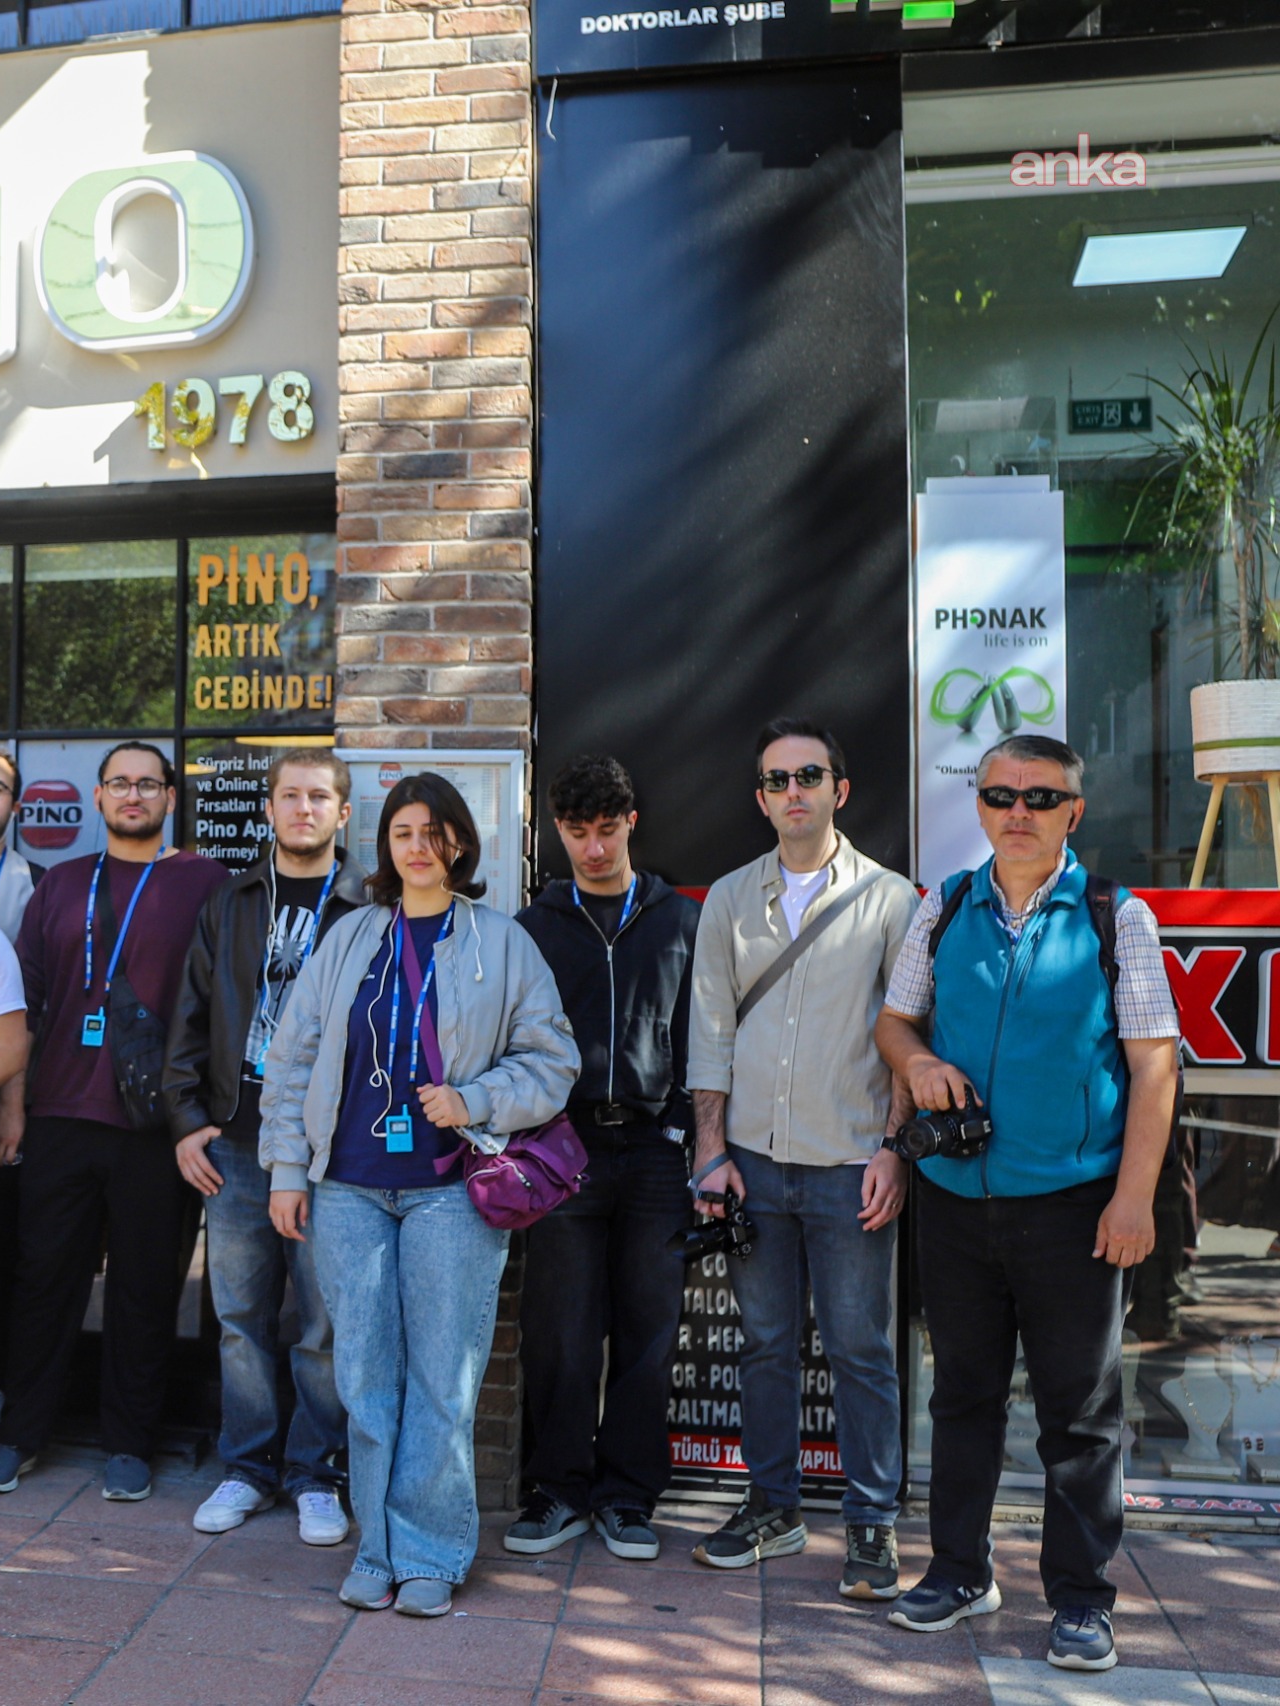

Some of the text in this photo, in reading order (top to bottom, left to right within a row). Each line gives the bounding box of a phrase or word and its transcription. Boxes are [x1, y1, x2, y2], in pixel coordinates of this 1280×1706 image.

[581, 1, 786, 34] DOKTORLAR ŞUBE
[134, 370, 315, 451] 1978
[196, 545, 318, 610] PİNO,
[935, 607, 1047, 629] PHONAK
[194, 623, 281, 658] ARTIK
[984, 633, 1048, 647] life is on
[194, 669, 332, 710] CEBİNDE!
[196, 756, 245, 774] Sürpriz
[196, 781, 212, 792] ve
[215, 777, 258, 792] Online
[196, 798, 256, 813] Fırsatları
[196, 819, 237, 838] Pino
[196, 844, 259, 862] indirmeyi
[672, 1436, 720, 1464] TÜRLÜ
